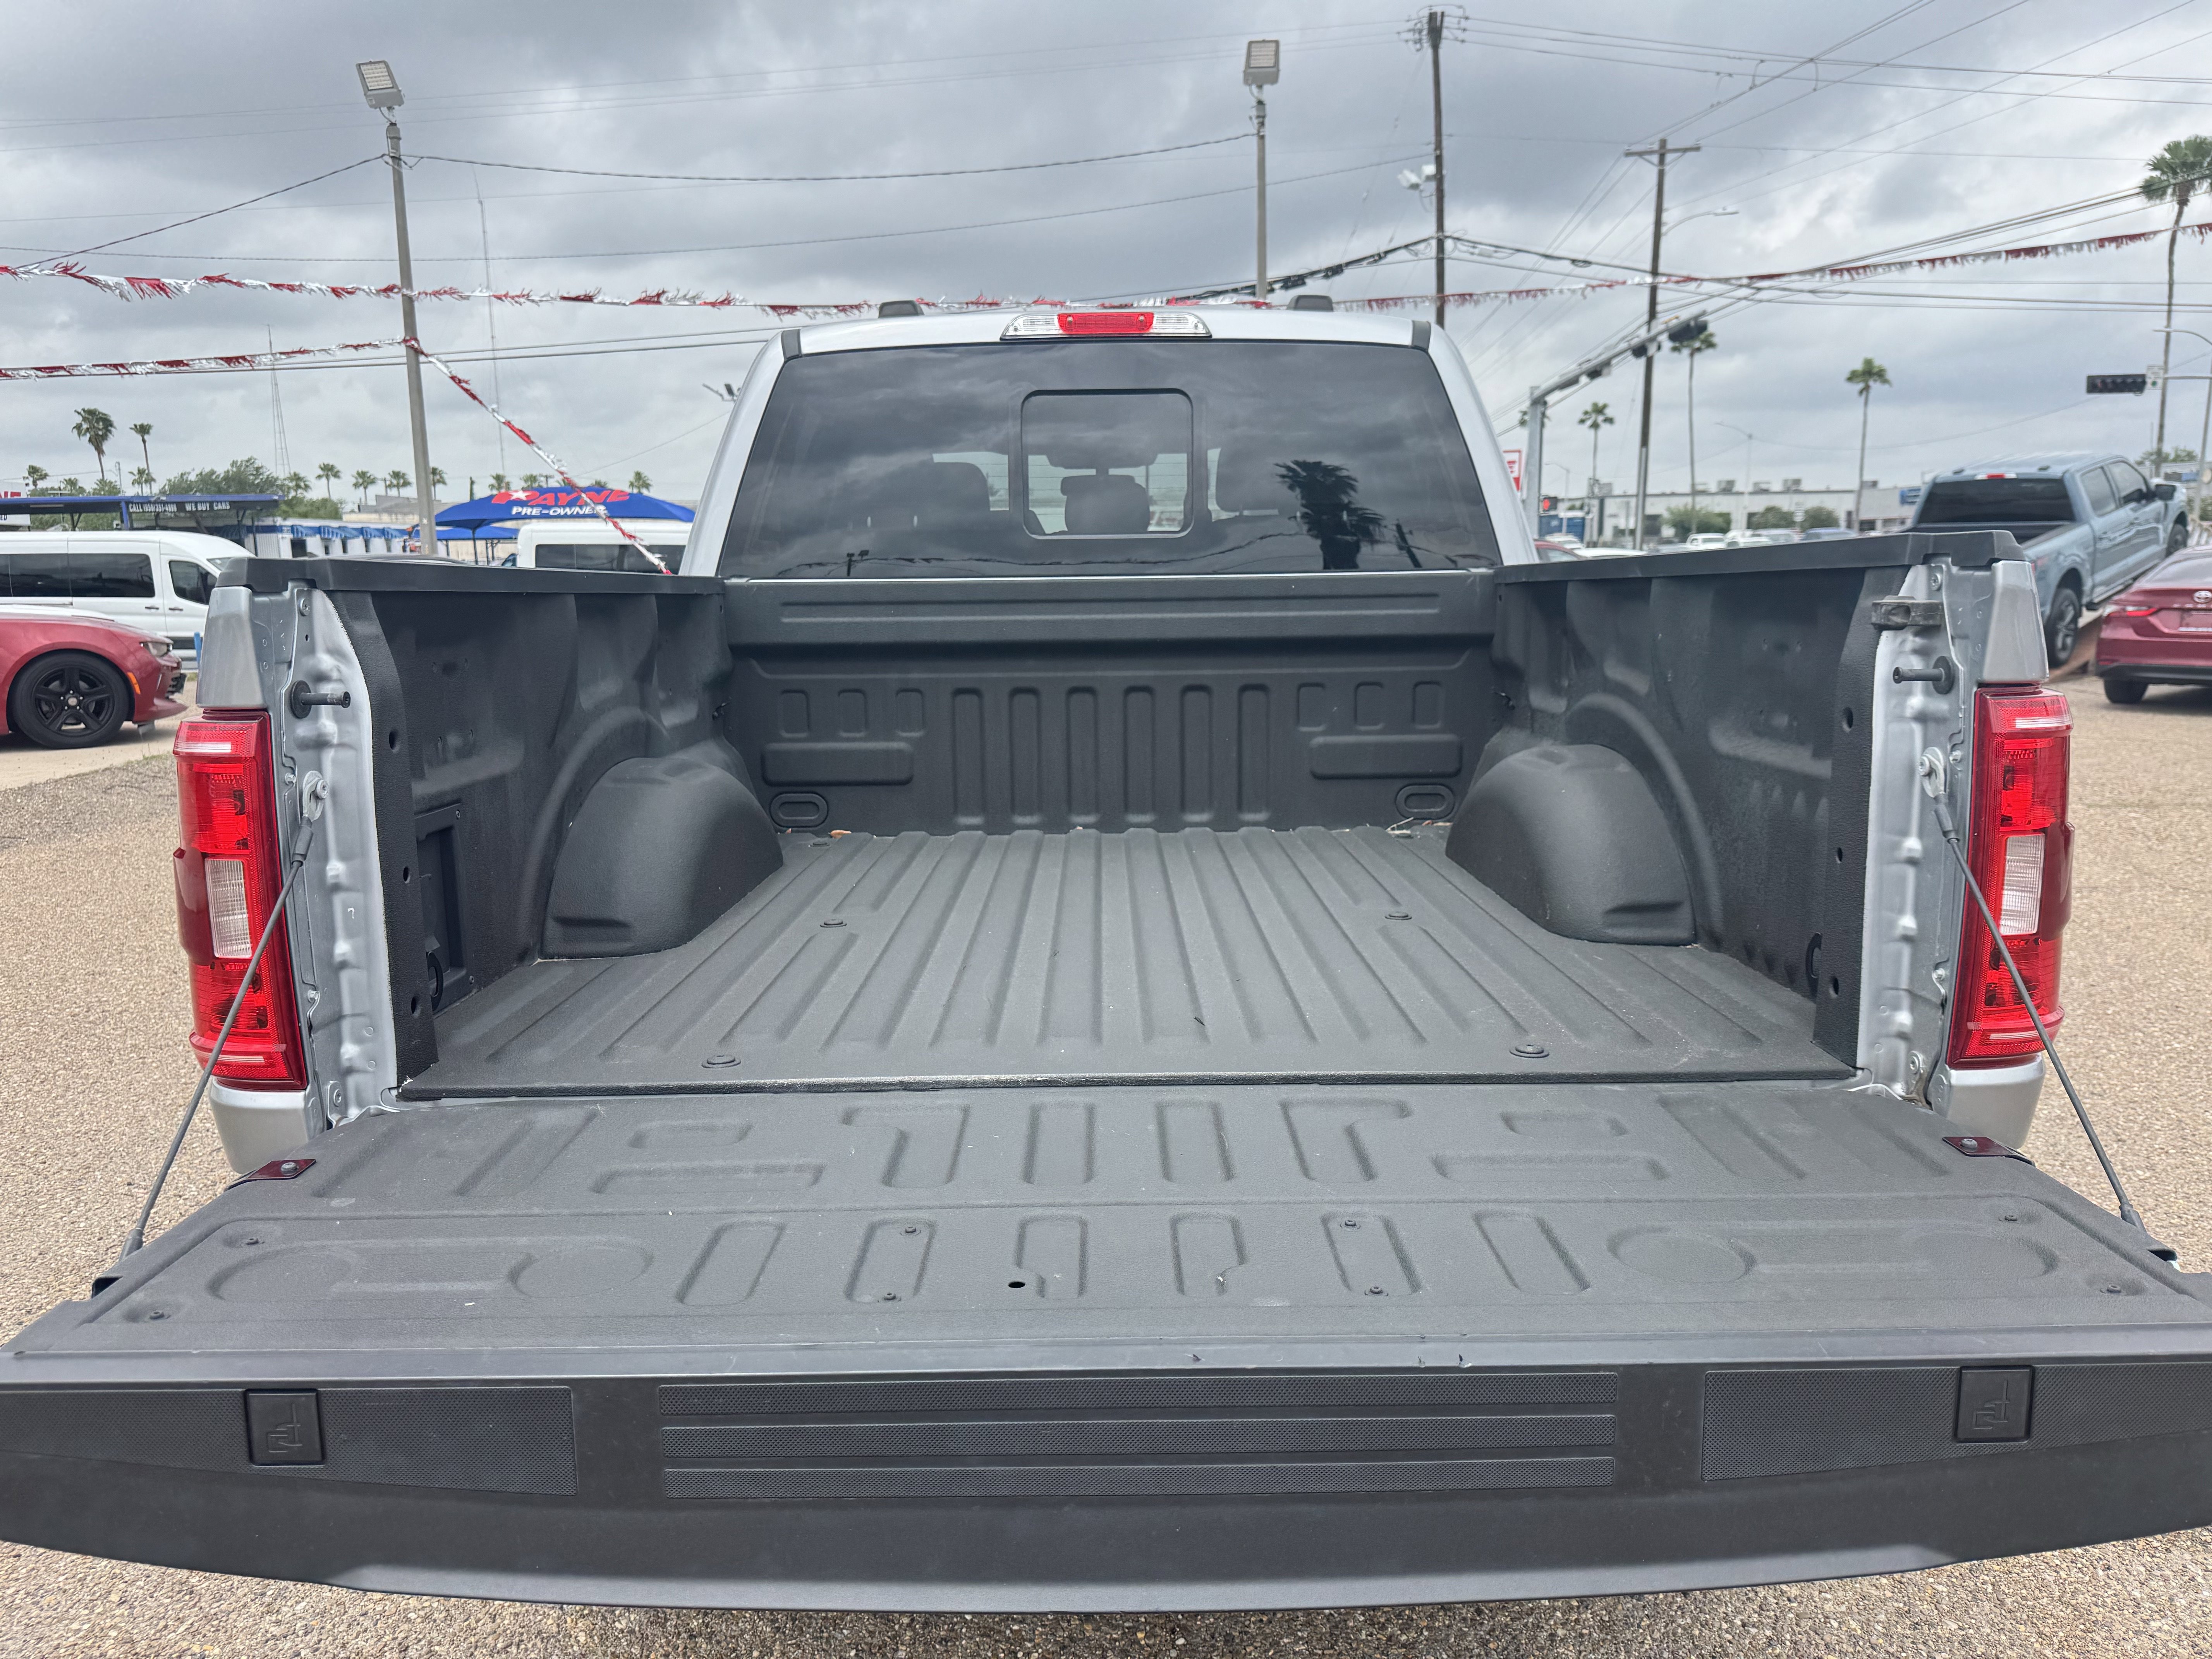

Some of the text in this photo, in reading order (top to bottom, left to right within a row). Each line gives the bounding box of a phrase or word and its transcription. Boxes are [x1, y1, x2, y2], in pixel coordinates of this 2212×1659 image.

[491, 489, 630, 506] PAYNE
[129, 503, 143, 512] CALL
[185, 502, 196, 511] WE
[197, 502, 210, 511] BUY
[511, 506, 607, 516] PRE-OWNE
